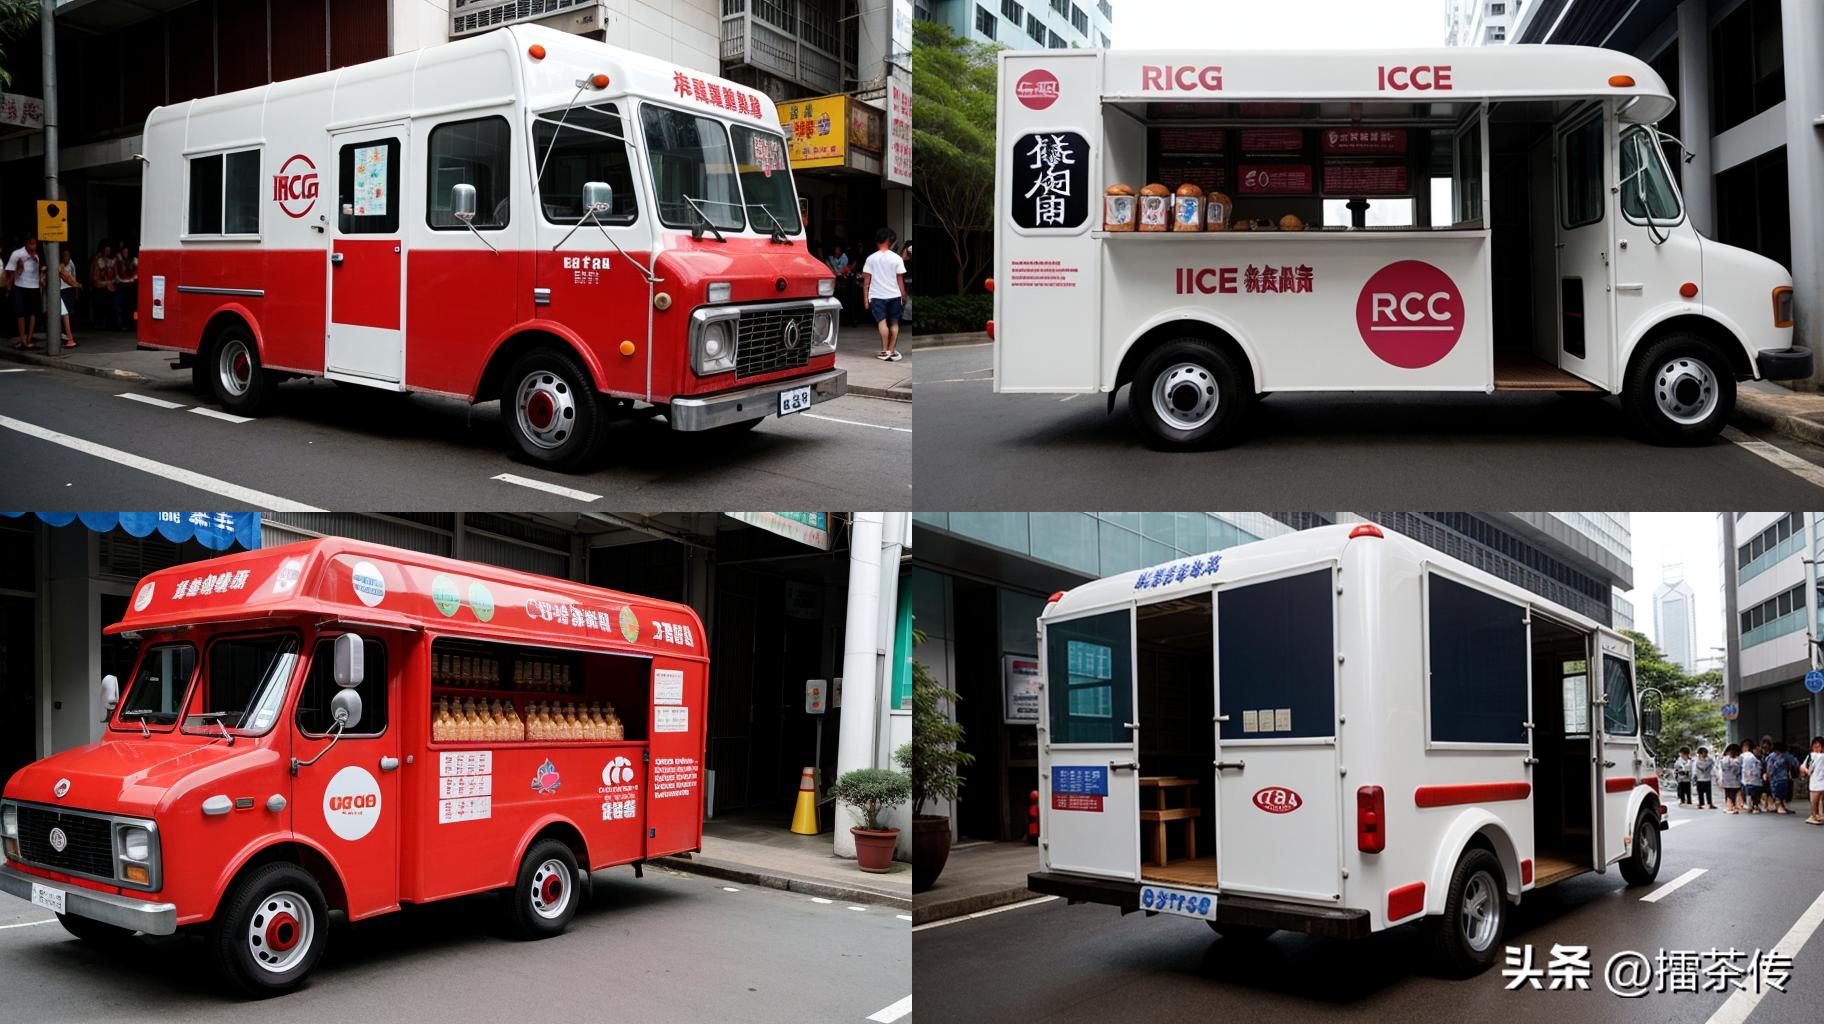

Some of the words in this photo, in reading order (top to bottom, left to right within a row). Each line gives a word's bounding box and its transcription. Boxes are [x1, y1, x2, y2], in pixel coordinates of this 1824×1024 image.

[1142, 65, 1223, 91] RICG
[1378, 65, 1453, 91] ICCE
[1176, 267, 1238, 294] IICE
[1372, 291, 1452, 322] RCC
